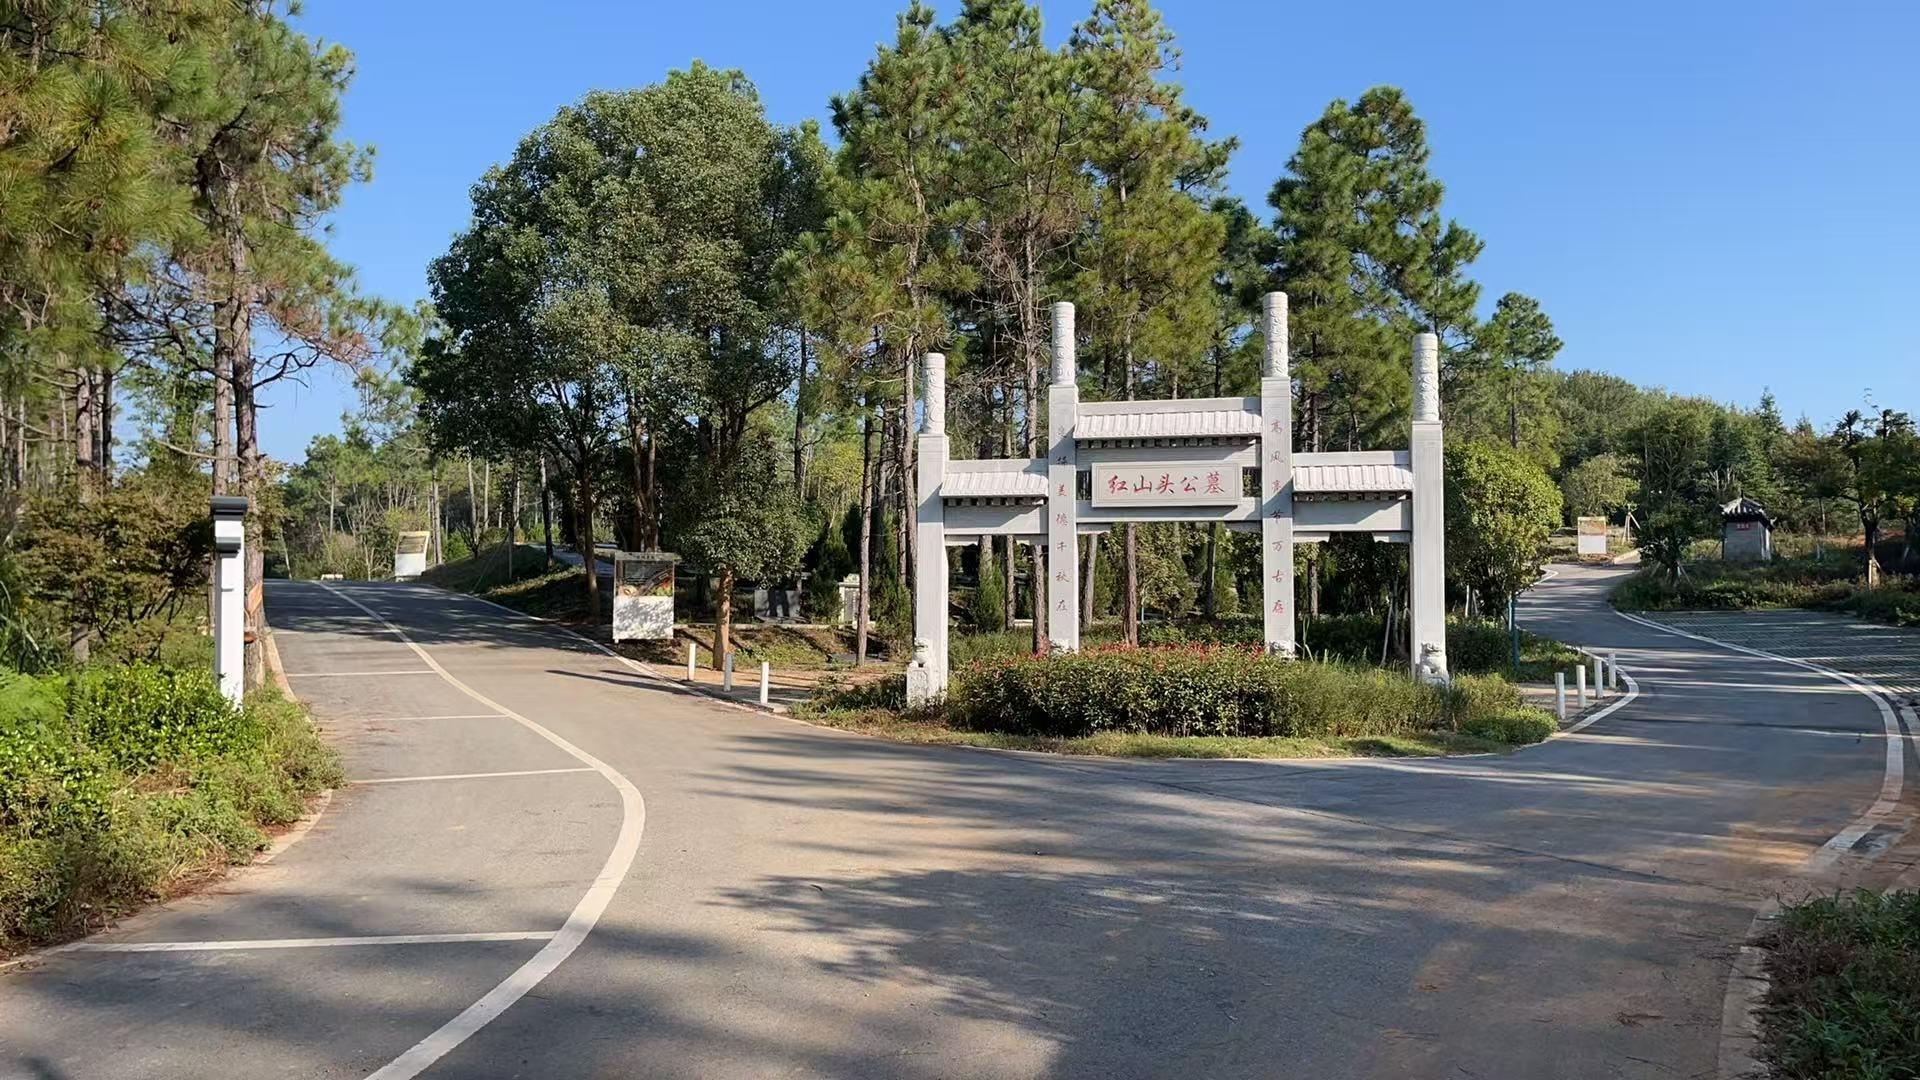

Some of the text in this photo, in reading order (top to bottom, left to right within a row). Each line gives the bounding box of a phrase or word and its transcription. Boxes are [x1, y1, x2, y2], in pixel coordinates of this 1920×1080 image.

[1106, 471, 1226, 495] 红山头公墓
